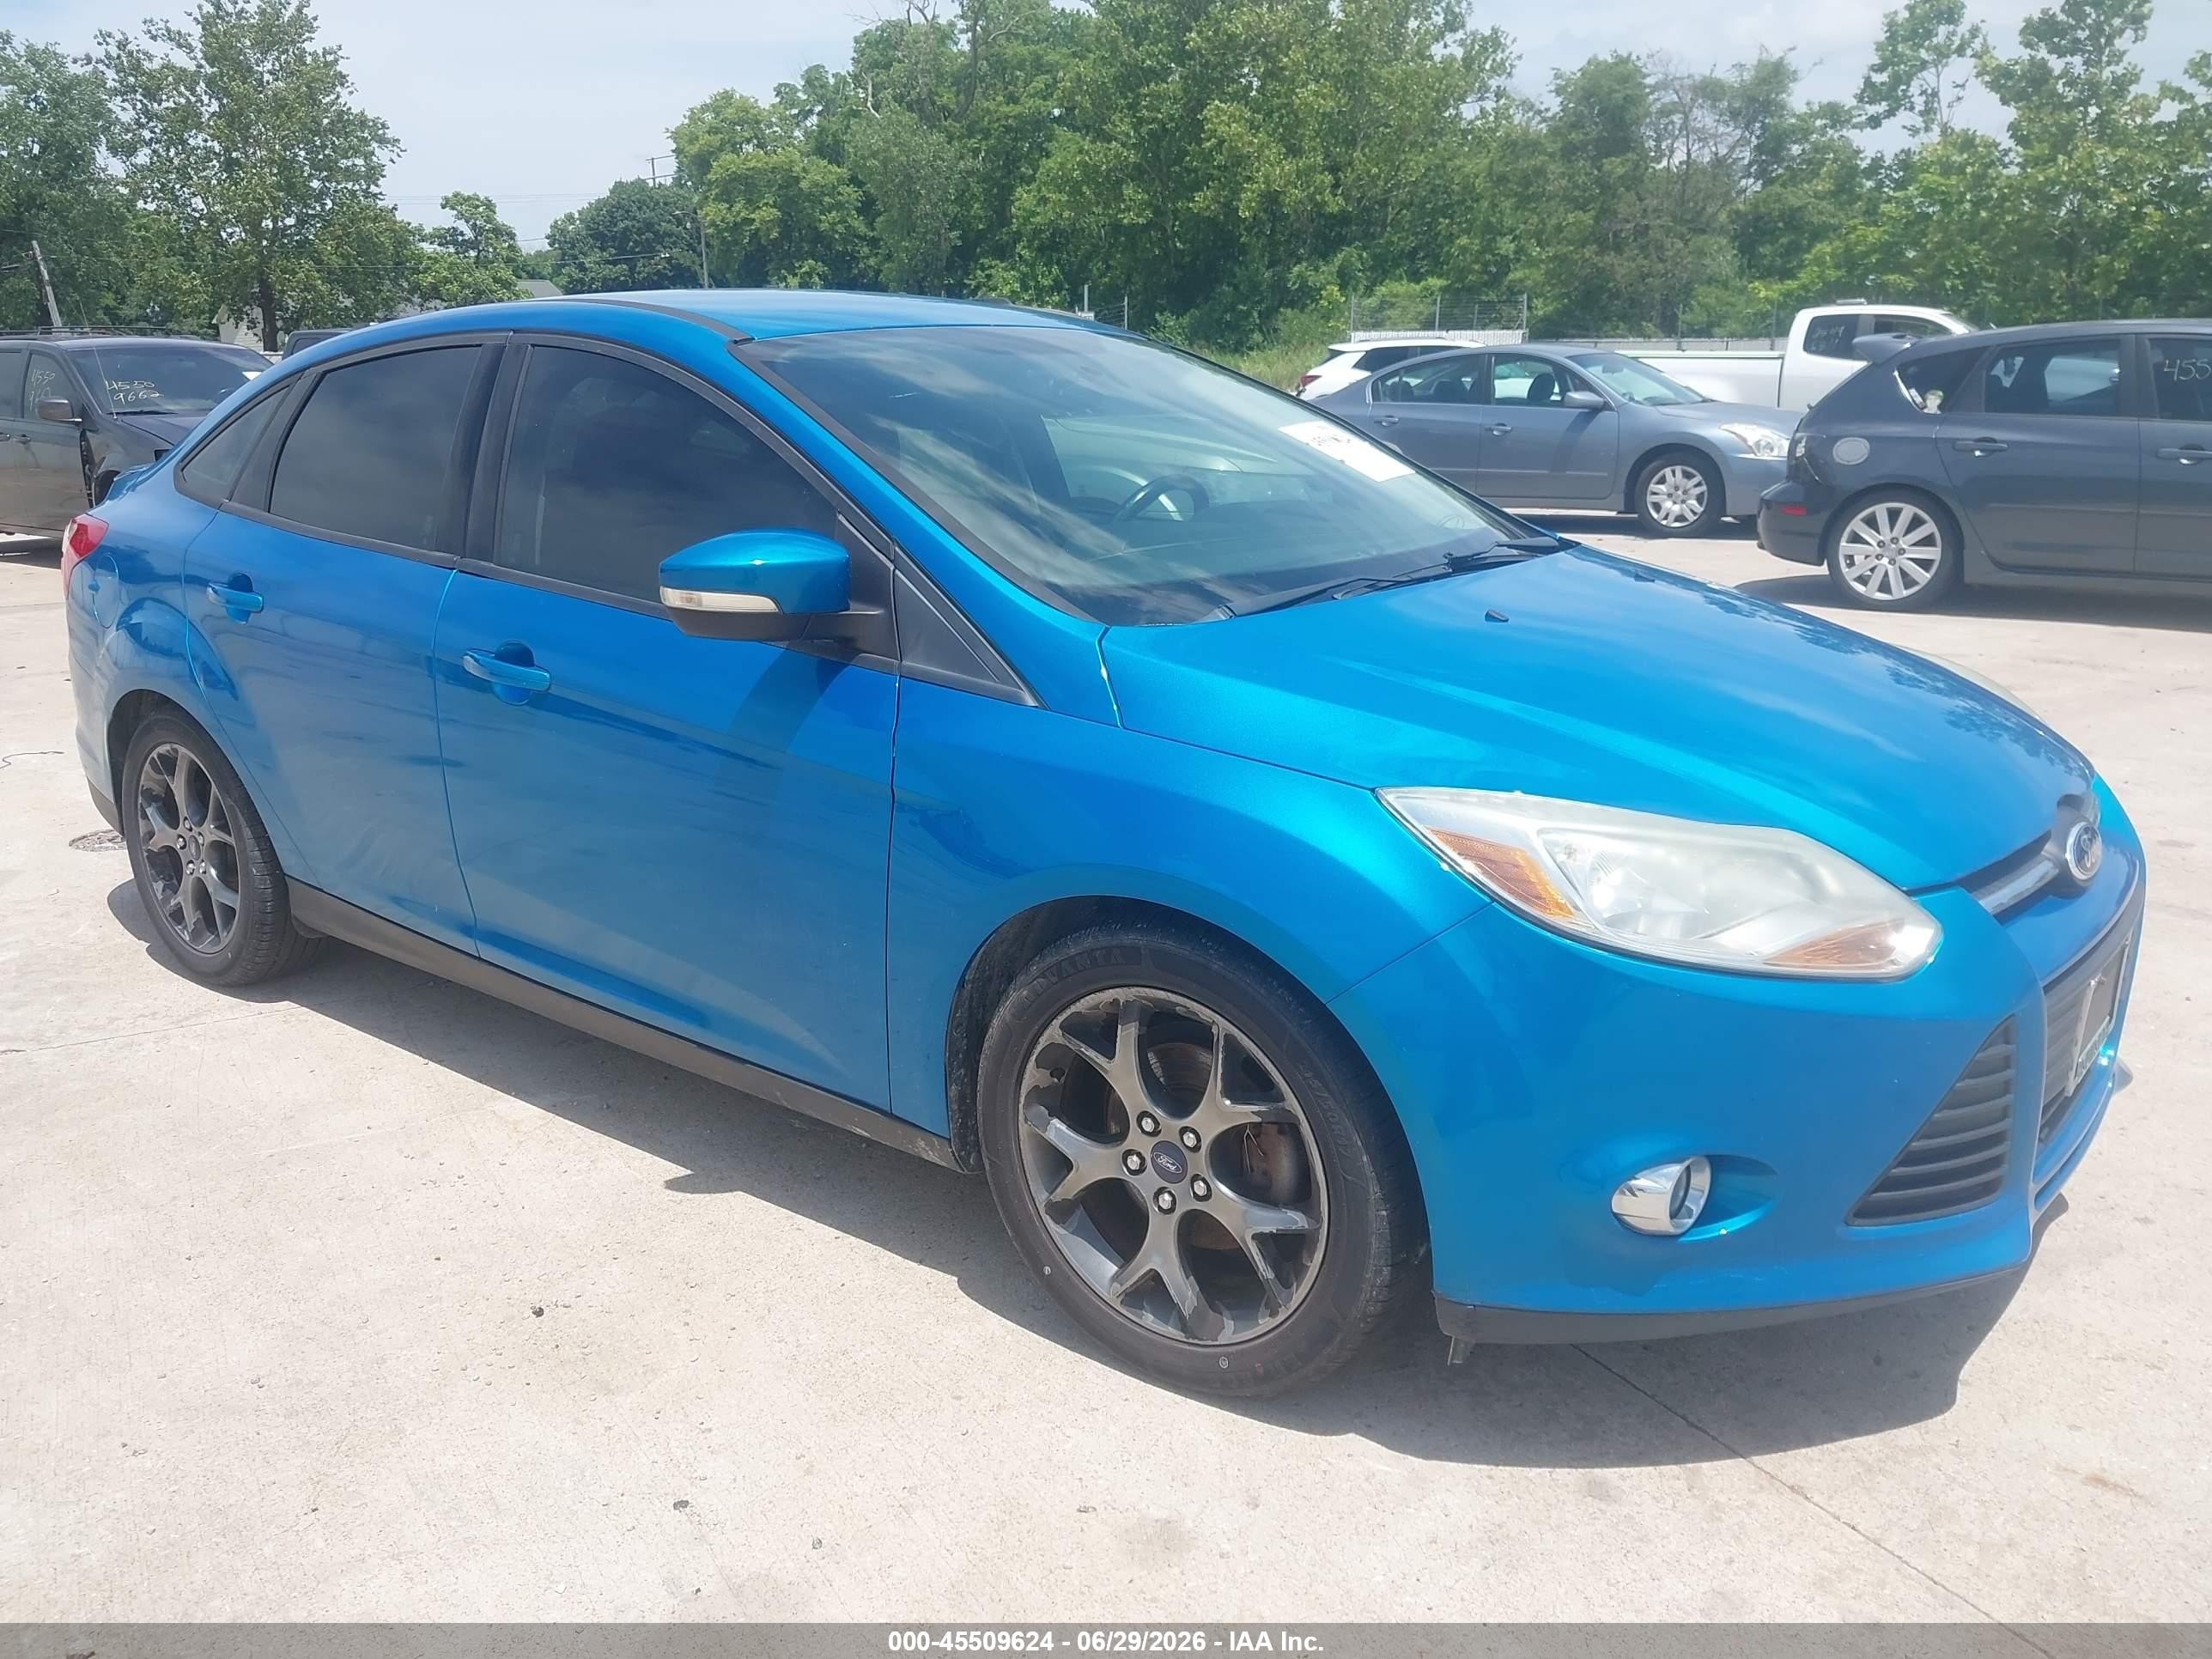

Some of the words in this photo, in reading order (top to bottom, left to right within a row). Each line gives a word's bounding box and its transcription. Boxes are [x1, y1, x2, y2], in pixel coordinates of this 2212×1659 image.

[105, 380, 155, 391] 4550
[114, 390, 165, 404] 9662
[1158, 1155, 1177, 1170] Ford
